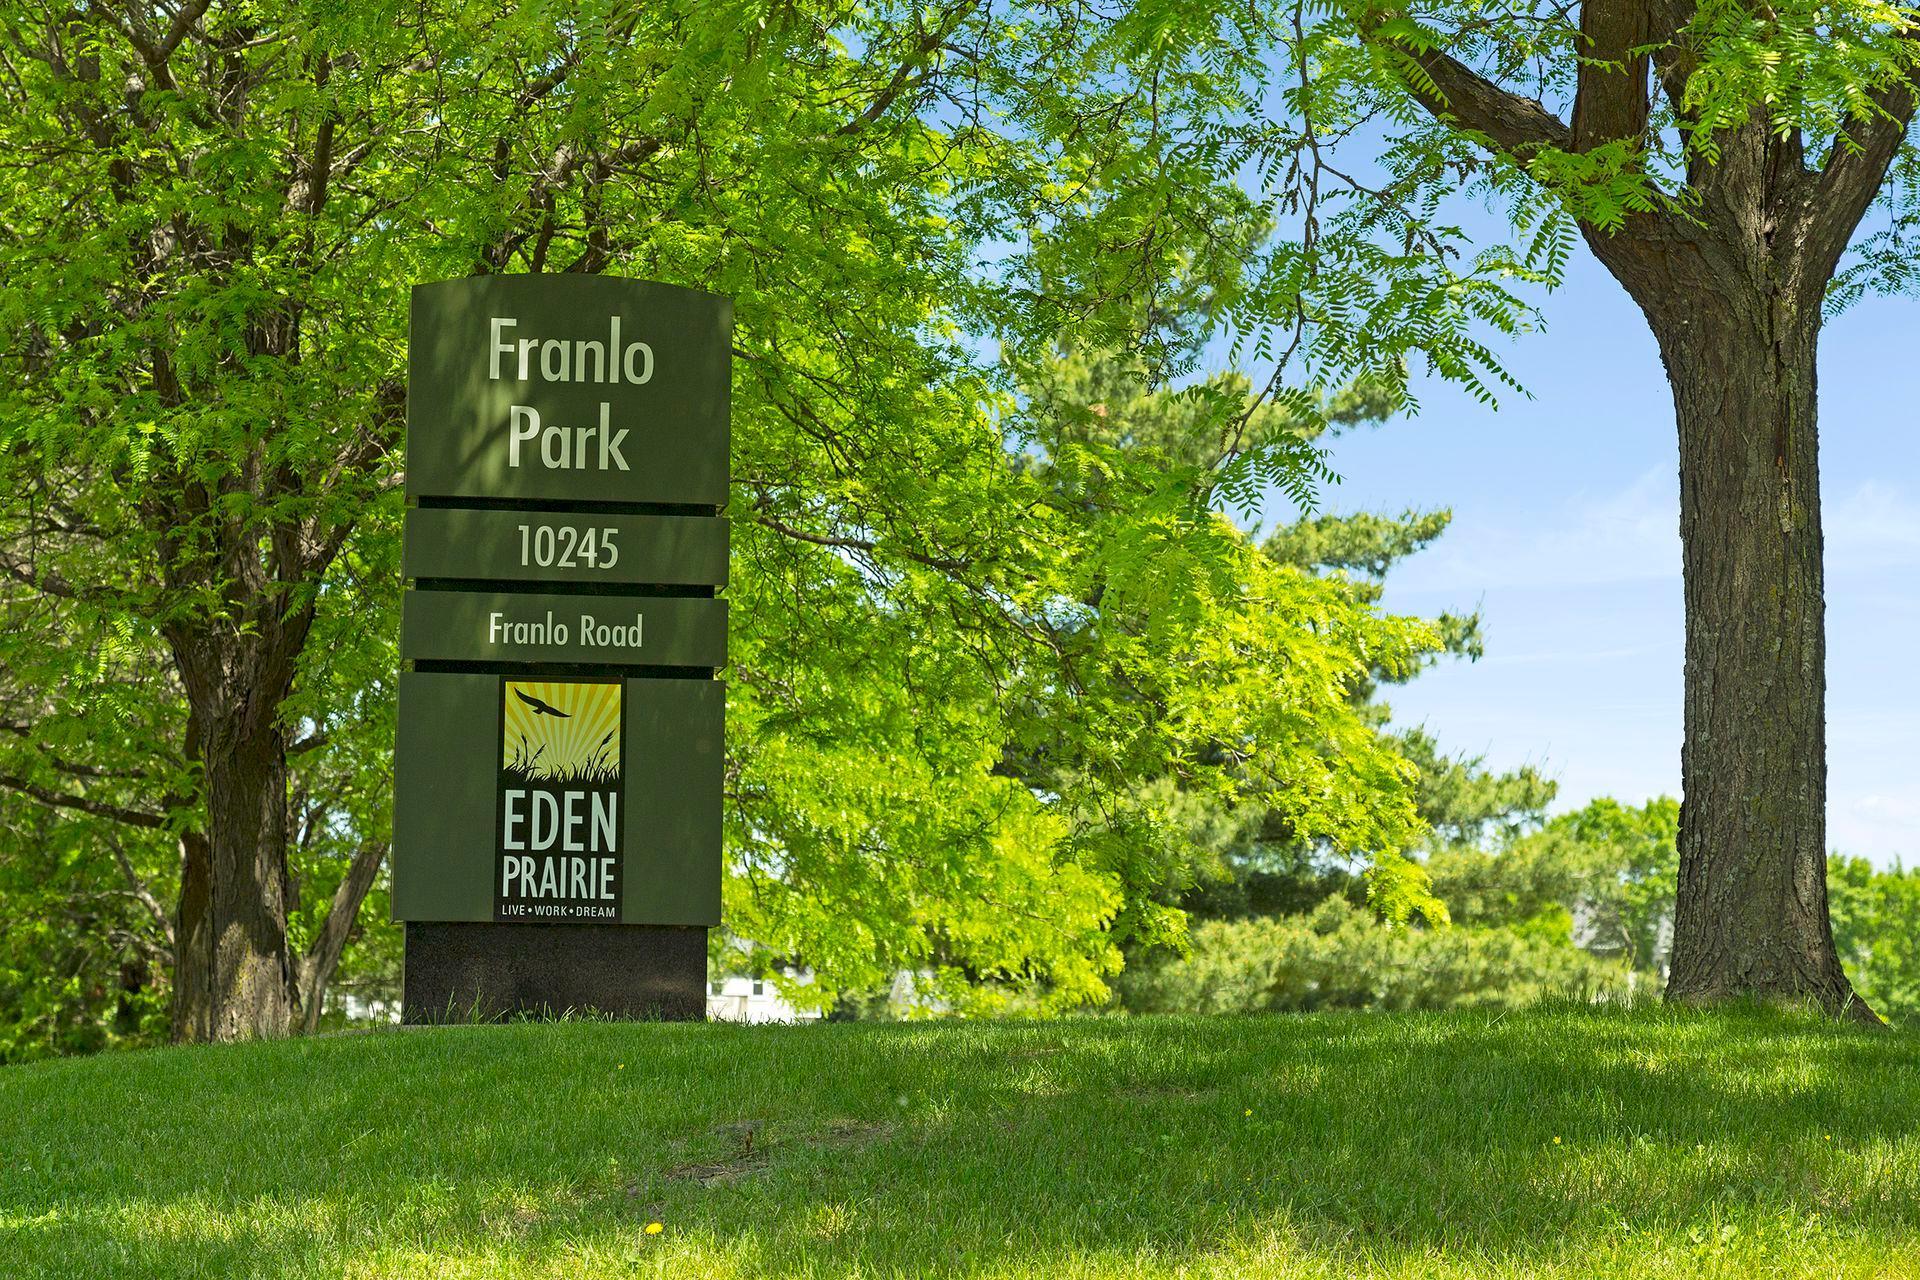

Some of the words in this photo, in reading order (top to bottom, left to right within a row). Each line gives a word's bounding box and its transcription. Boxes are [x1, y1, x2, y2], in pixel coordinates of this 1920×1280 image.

[488, 316, 655, 385] Franlo
[509, 402, 631, 471] Park
[518, 525, 619, 569] 10245
[489, 611, 568, 645] Franlo
[580, 613, 643, 648] Road
[503, 789, 617, 852] EDEN
[502, 855, 616, 900] PRAIRIE
